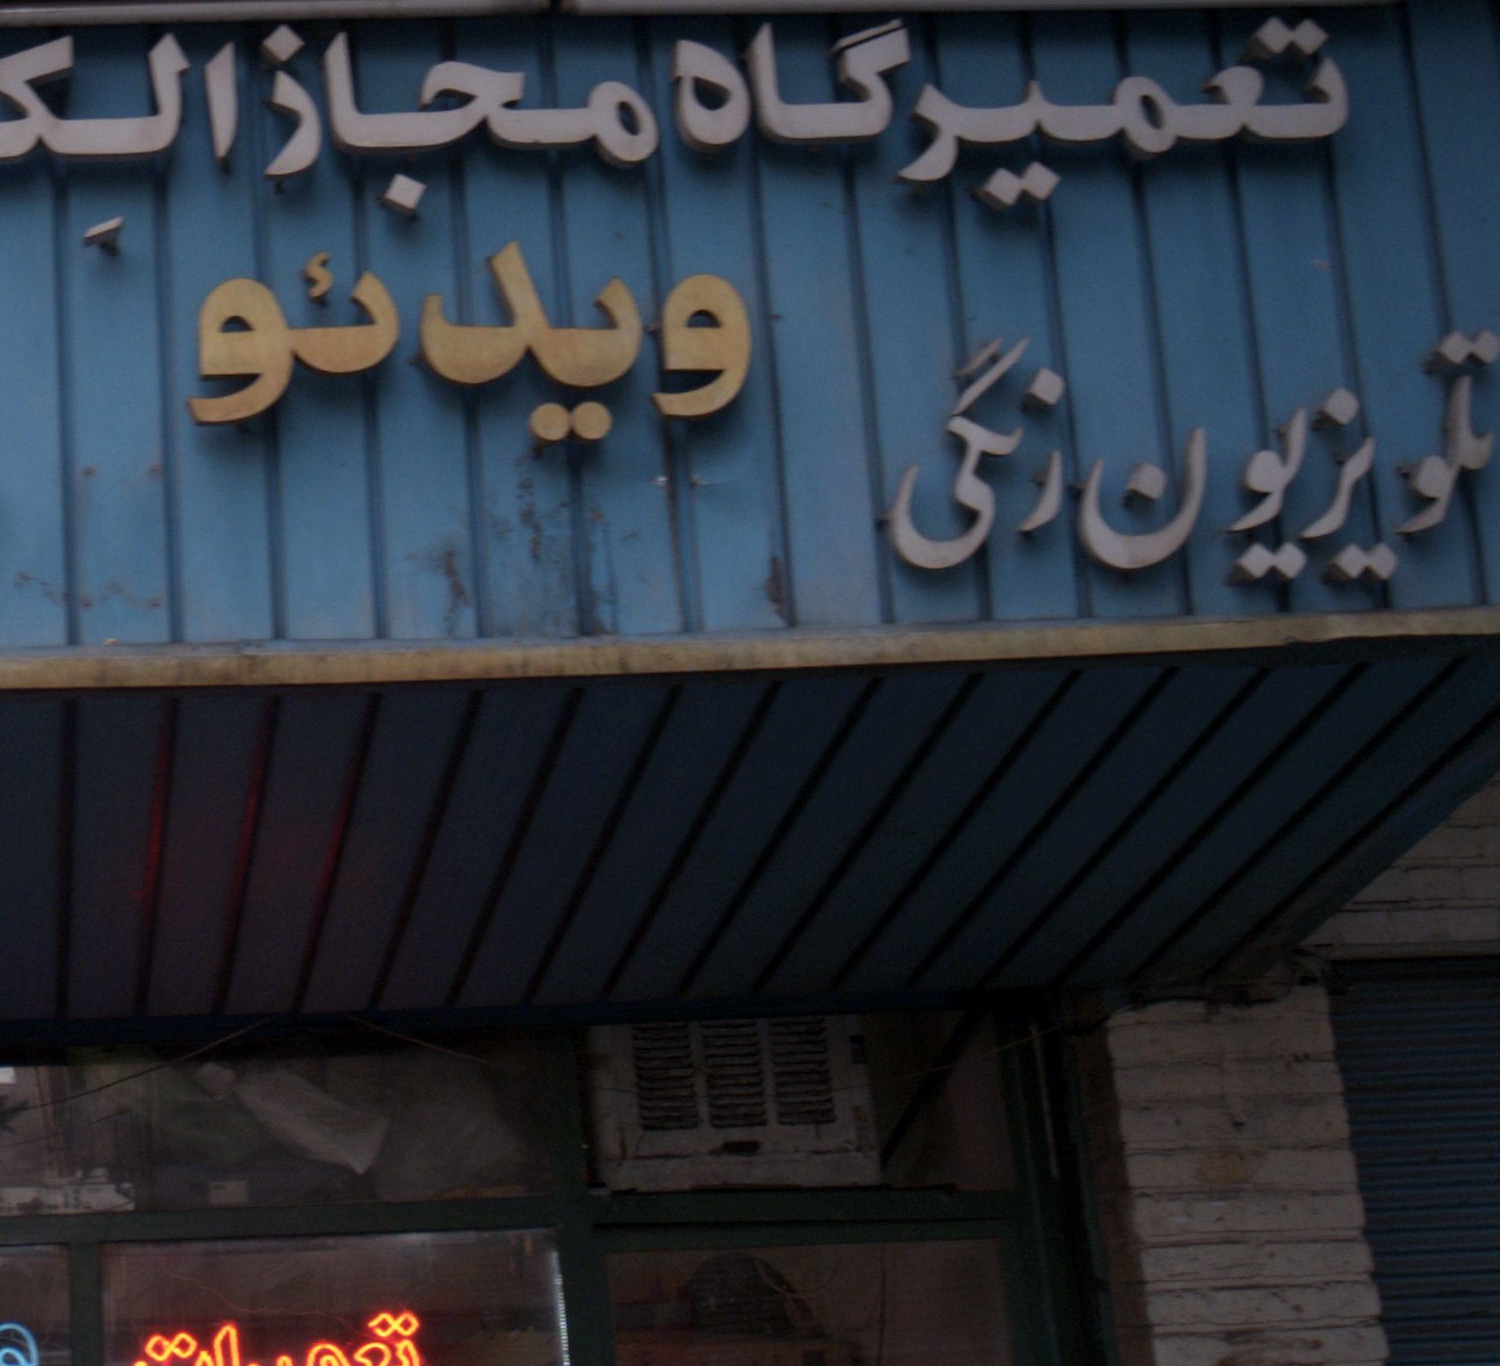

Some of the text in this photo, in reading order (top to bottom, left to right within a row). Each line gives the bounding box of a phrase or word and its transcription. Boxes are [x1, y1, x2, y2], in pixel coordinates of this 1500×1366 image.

[263, 24, 659, 218] مجاز
[188, 240, 752, 443] ویدئو
[888, 328, 1499, 583] تلویزیون رنگی
